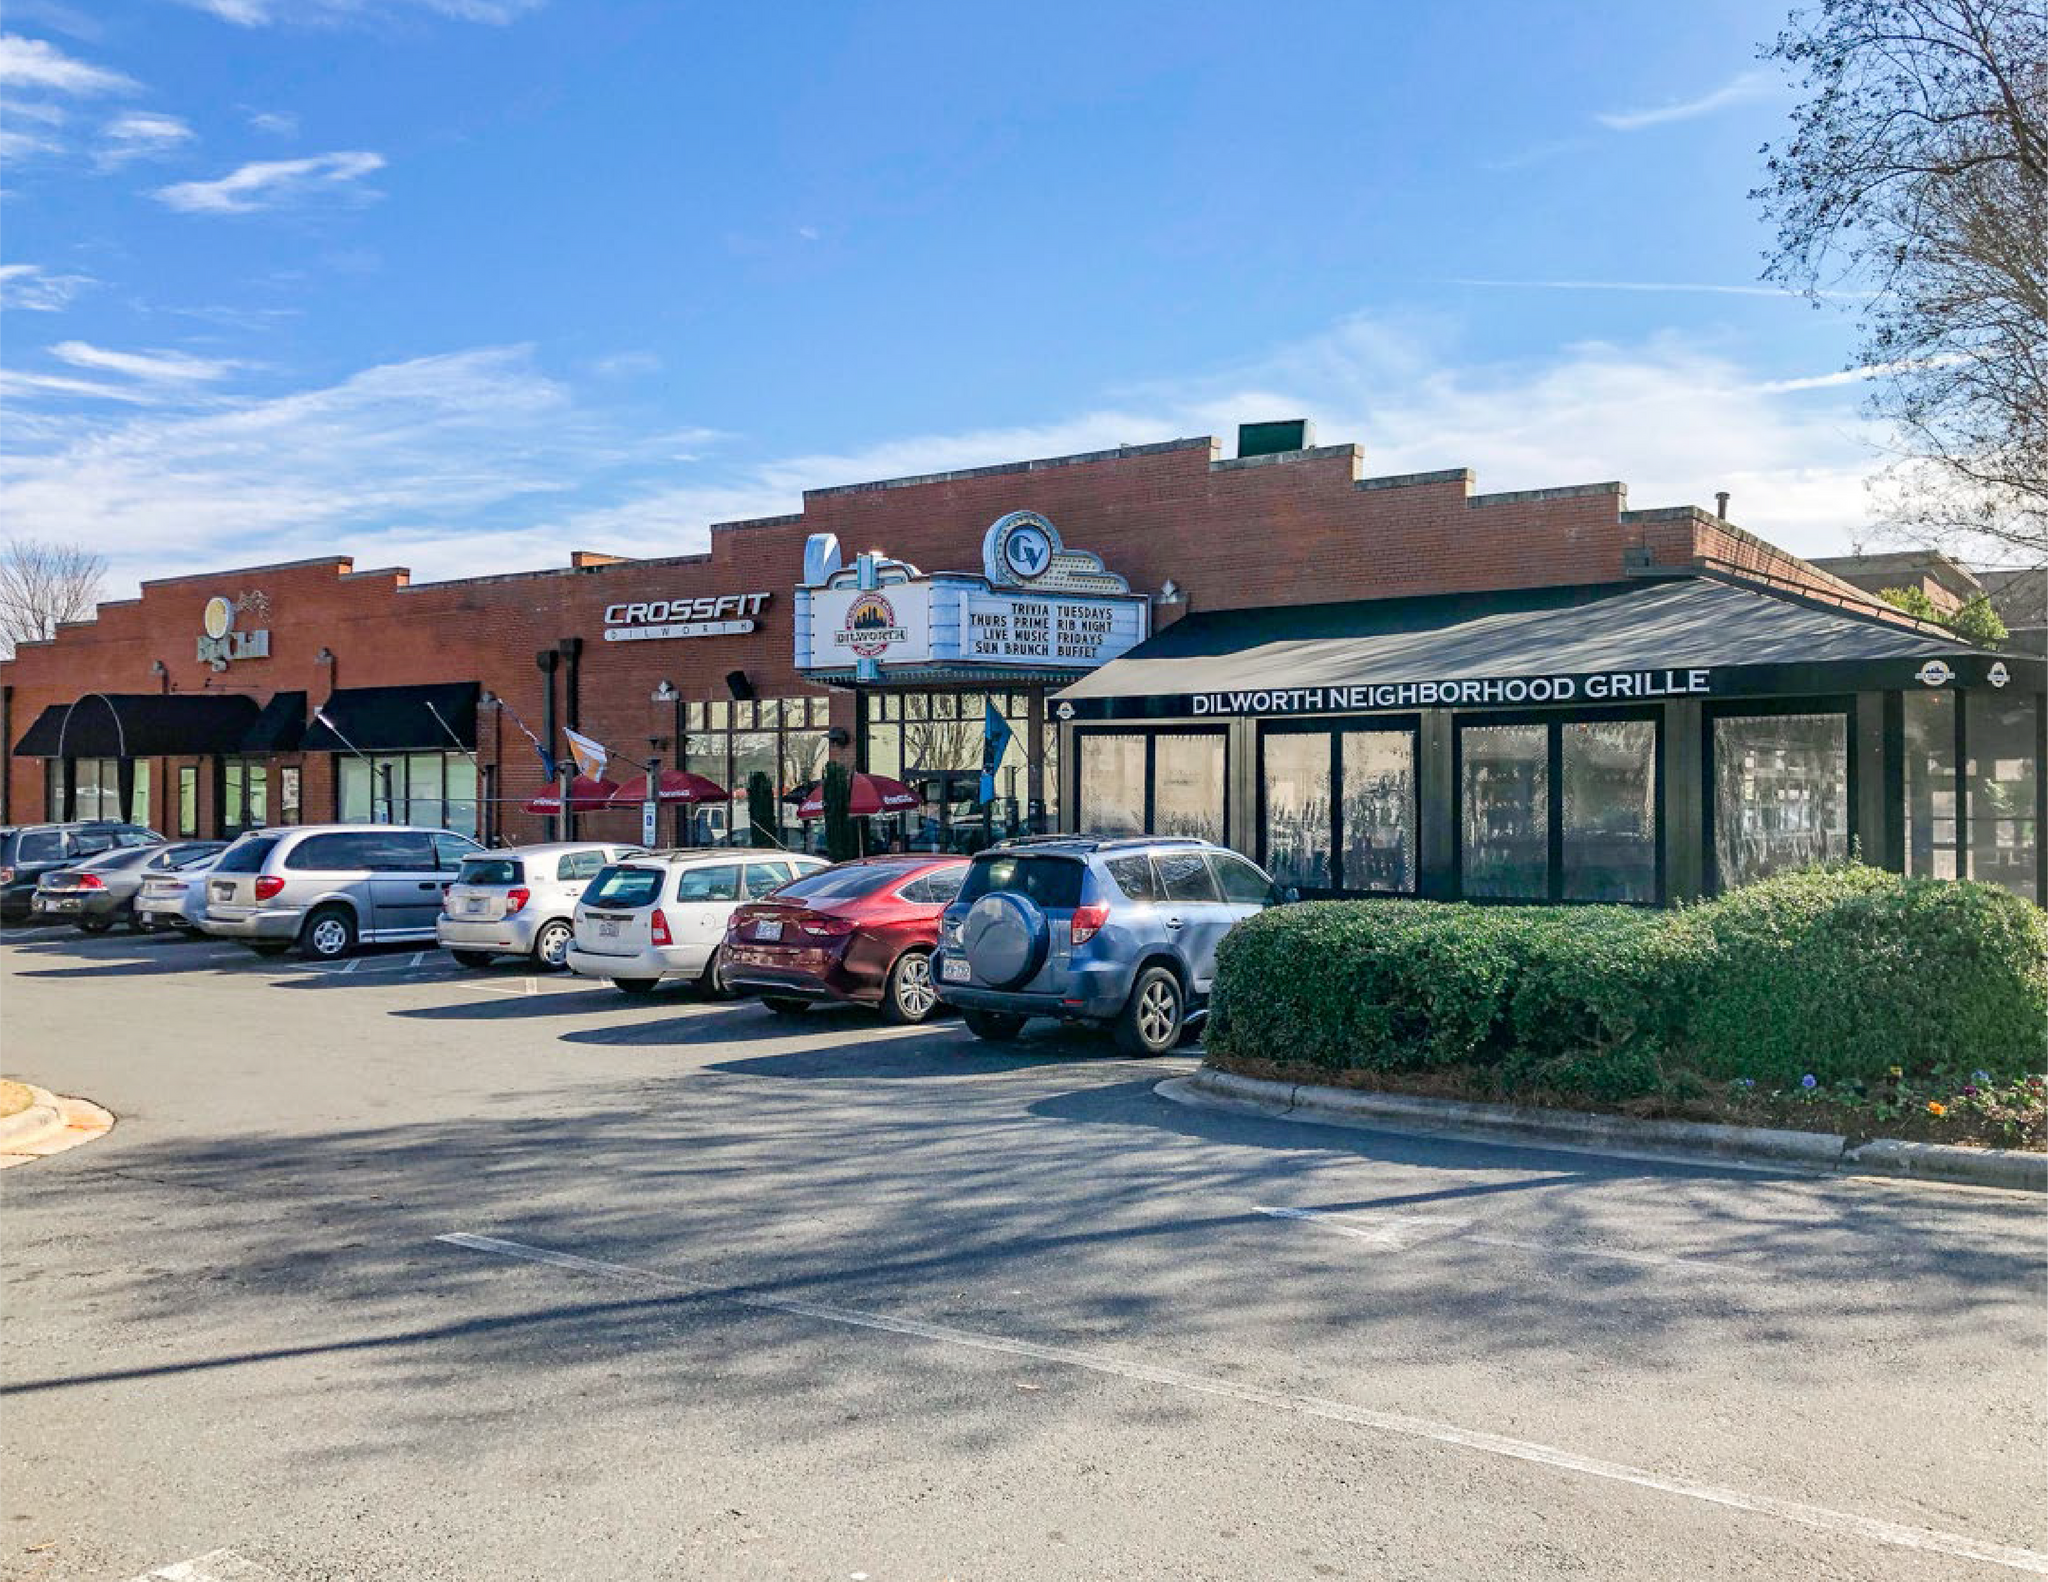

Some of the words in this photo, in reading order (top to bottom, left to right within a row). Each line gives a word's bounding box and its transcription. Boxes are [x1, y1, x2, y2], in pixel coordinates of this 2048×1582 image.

[604, 592, 771, 624] CROSSFIT
[1012, 603, 1049, 615] TRIVIA
[1057, 606, 1113, 620] TUESDAYS
[970, 614, 1007, 627] THURS
[1013, 617, 1049, 629] PRIME
[1057, 619, 1075, 631] RIB
[1081, 621, 1112, 633] NIGHT
[837, 629, 906, 643] DILWORTH
[984, 628, 1008, 640] LIVE
[1015, 630, 1049, 642] MUSIC
[1057, 632, 1104, 645] FRIDAYS
[975, 641, 999, 654] SUN
[1005, 642, 1049, 655] BRUNCH
[1057, 645, 1097, 658] BUFFET
[1192, 688, 1323, 715] DILWORTH
[1329, 677, 1576, 708] NEIGHBORHOOD
[1584, 669, 1710, 697] GRILLE
